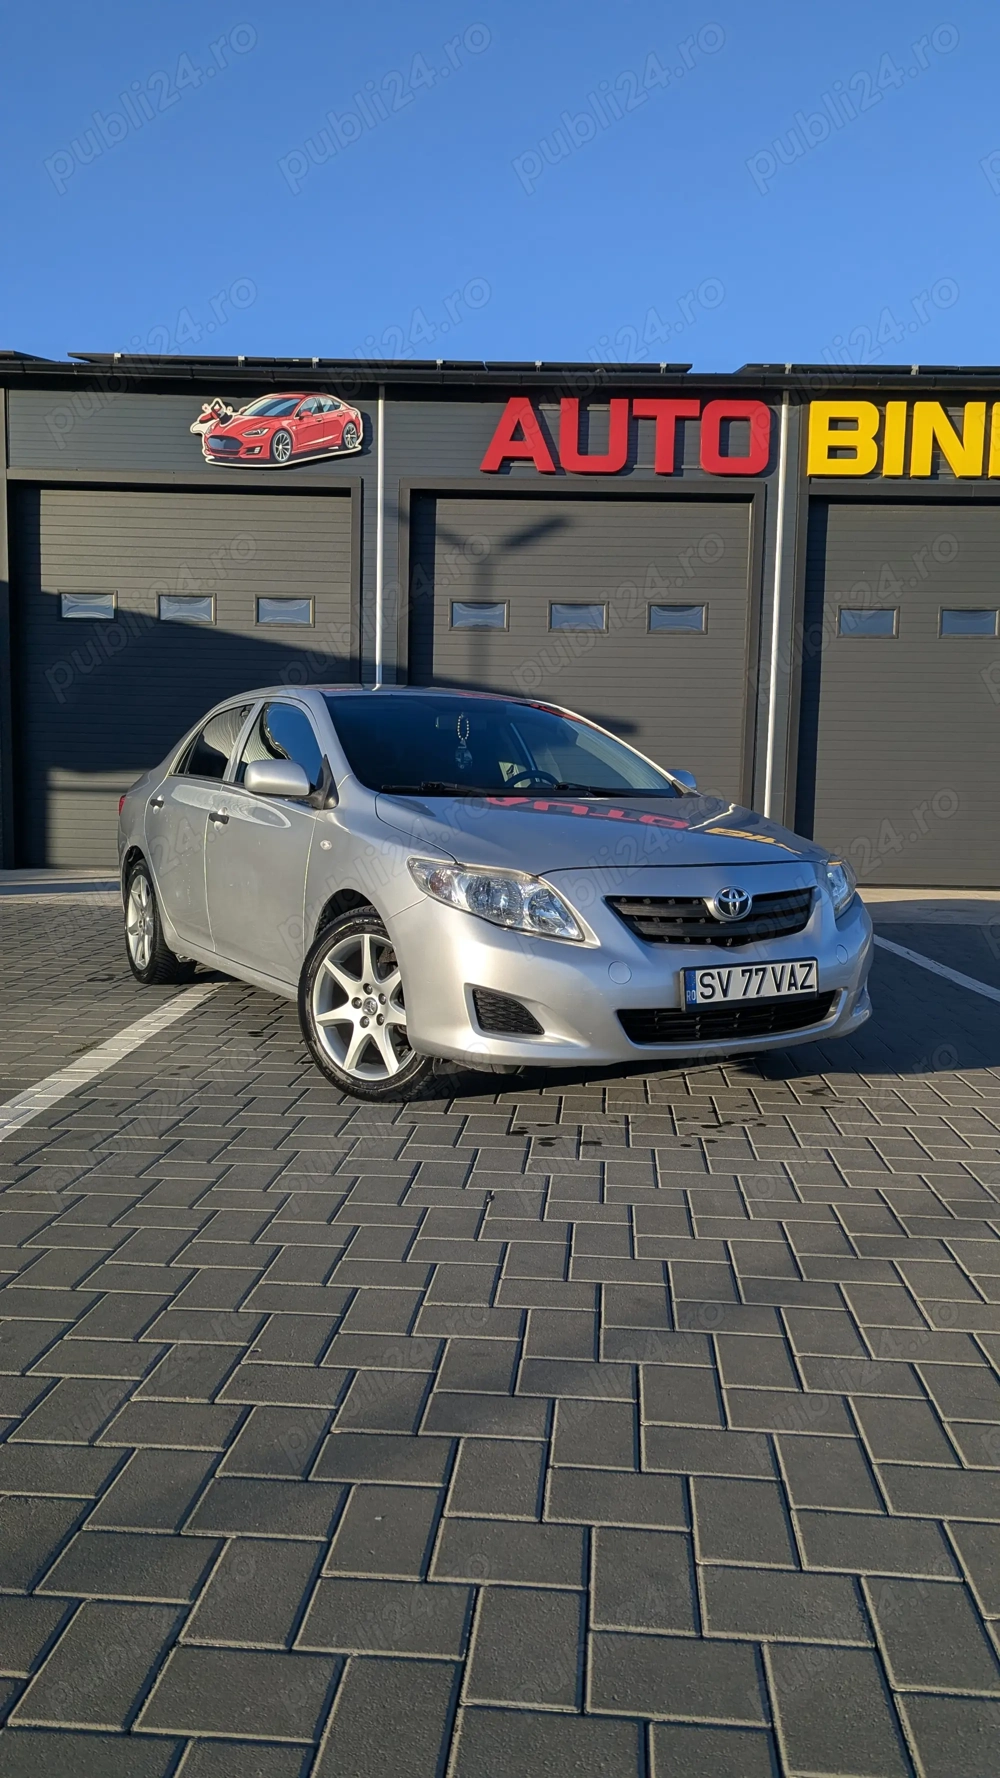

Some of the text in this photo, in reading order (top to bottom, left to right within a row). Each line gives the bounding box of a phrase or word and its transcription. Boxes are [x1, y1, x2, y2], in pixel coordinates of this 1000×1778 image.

[480, 397, 772, 476] AUTO
[700, 963, 814, 1000] SV 77 VAZ
